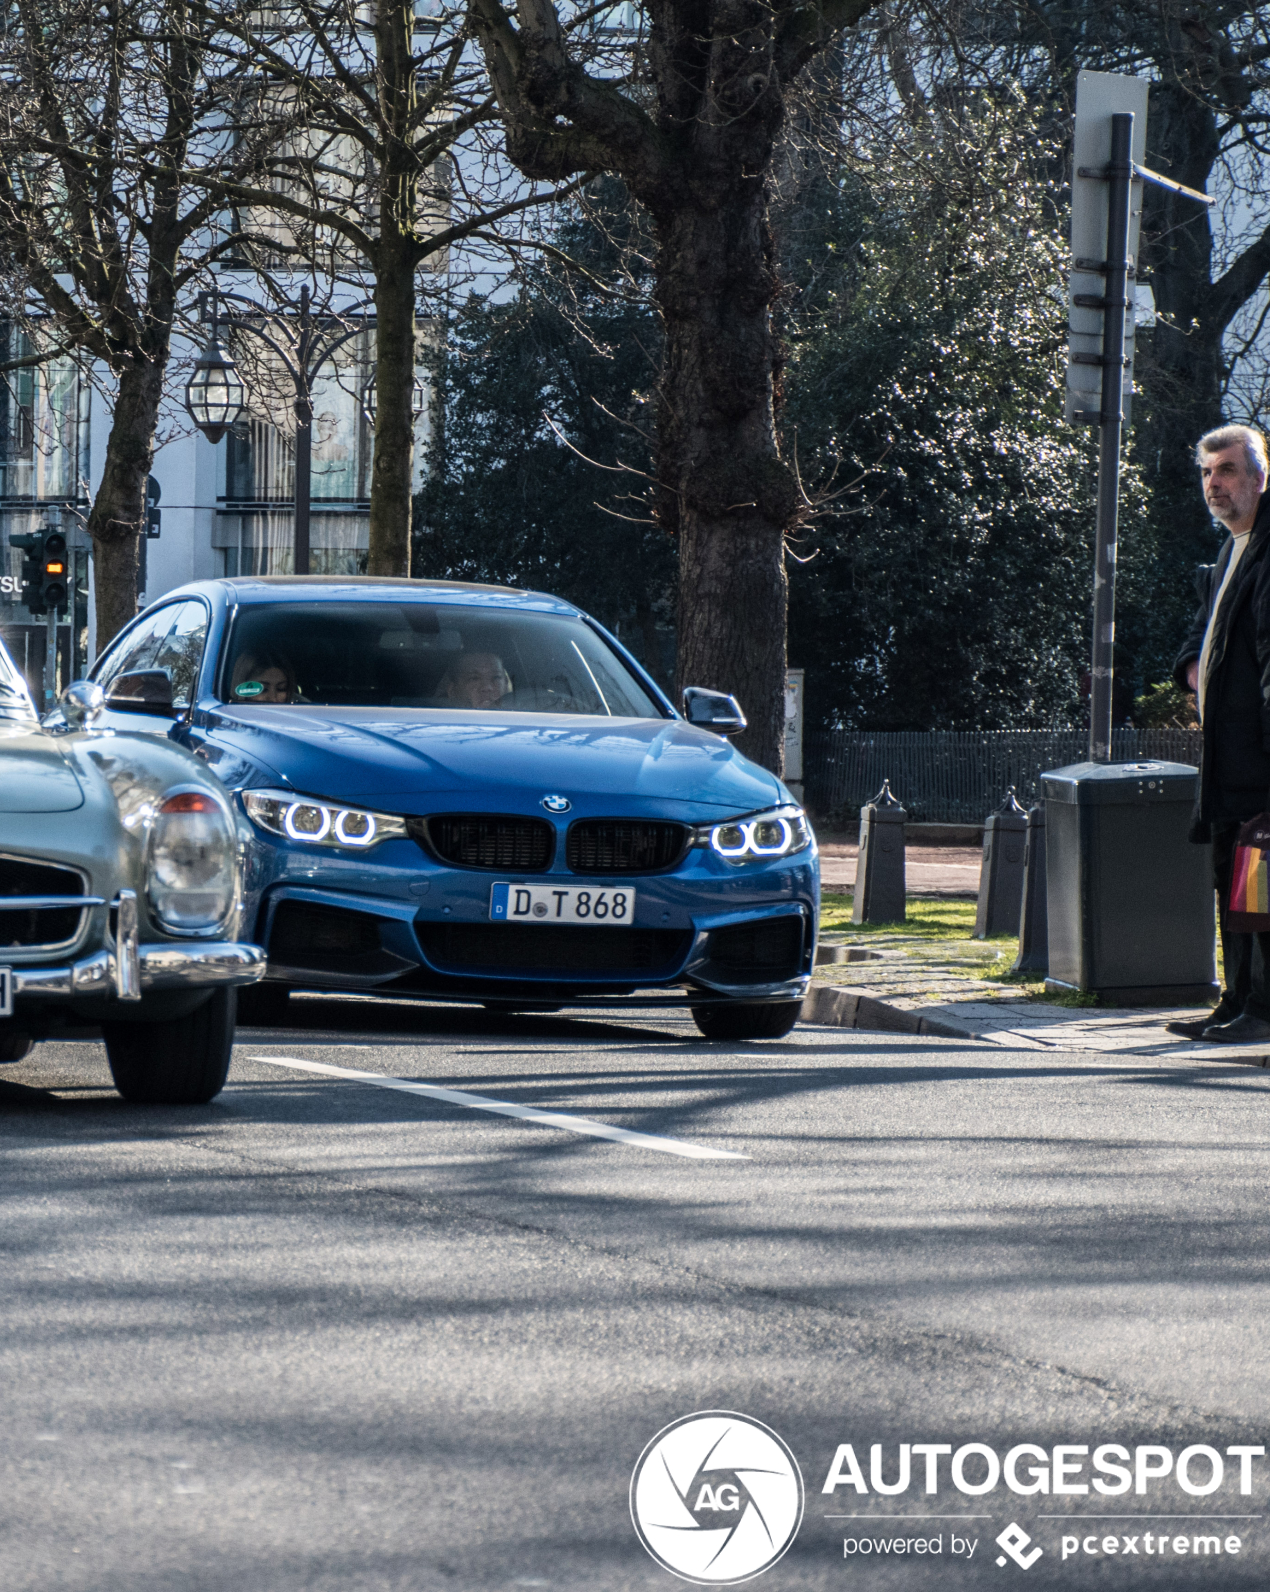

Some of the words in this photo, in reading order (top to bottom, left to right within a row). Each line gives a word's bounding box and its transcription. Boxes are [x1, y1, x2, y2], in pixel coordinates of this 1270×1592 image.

[495, 905, 503, 913] D
[513, 889, 531, 915] D
[552, 890, 569, 917] T
[575, 891, 627, 919] 868
